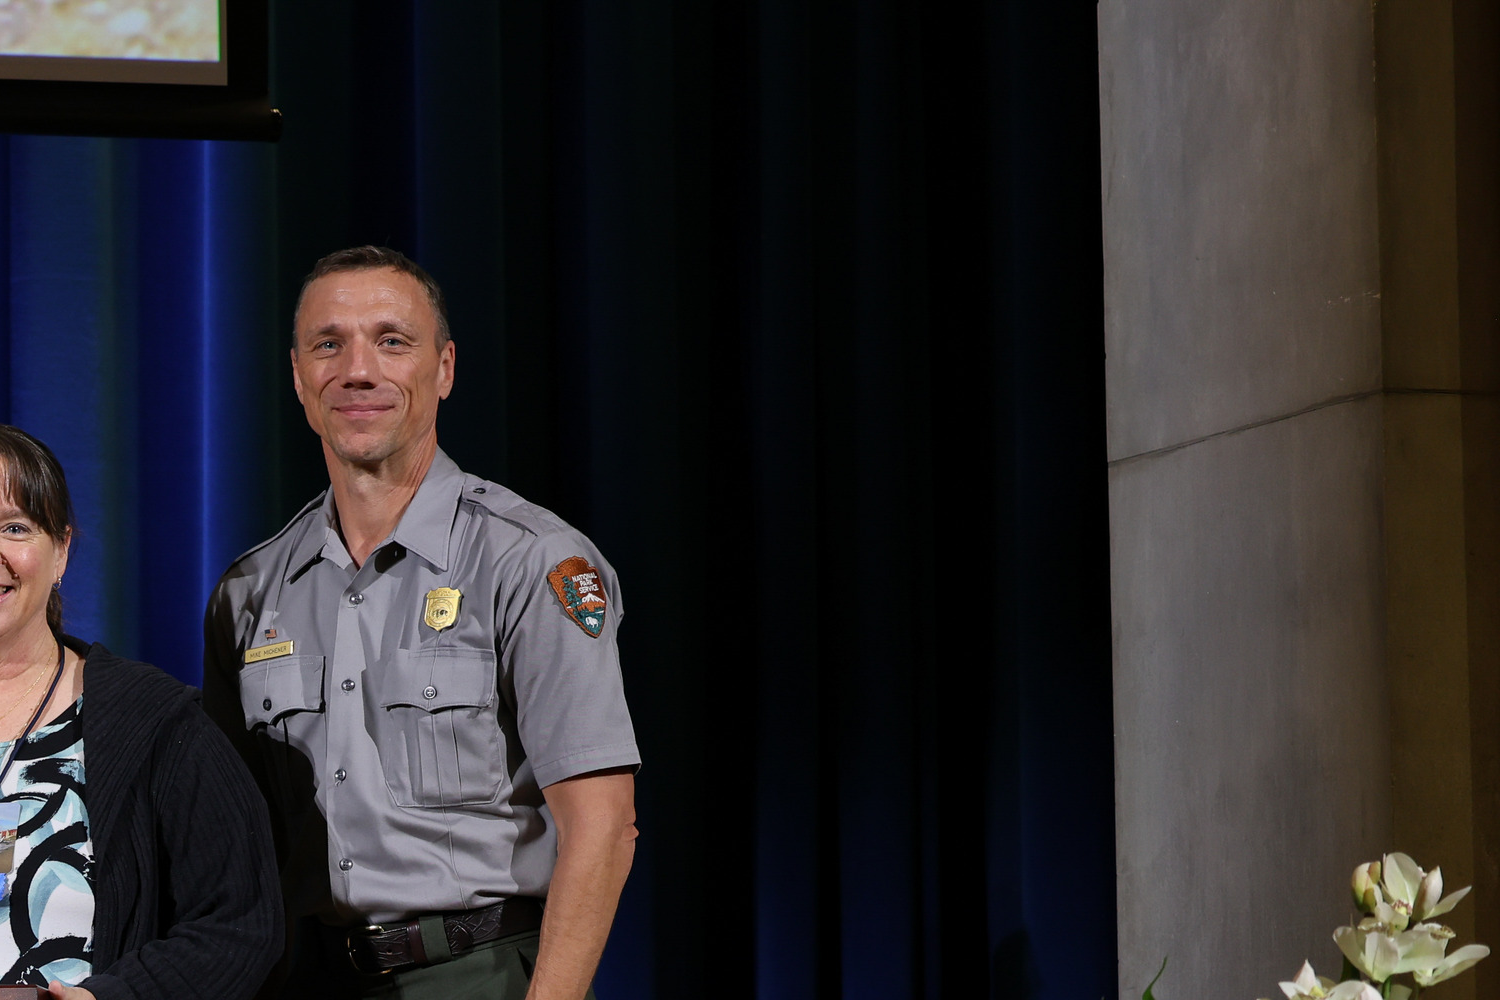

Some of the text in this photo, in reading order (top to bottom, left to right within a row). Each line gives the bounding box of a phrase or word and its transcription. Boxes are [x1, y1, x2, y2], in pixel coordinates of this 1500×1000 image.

[571, 572, 597, 583] NATIONAL
[579, 579, 593, 587] PARK
[578, 583, 599, 594] SERVICE
